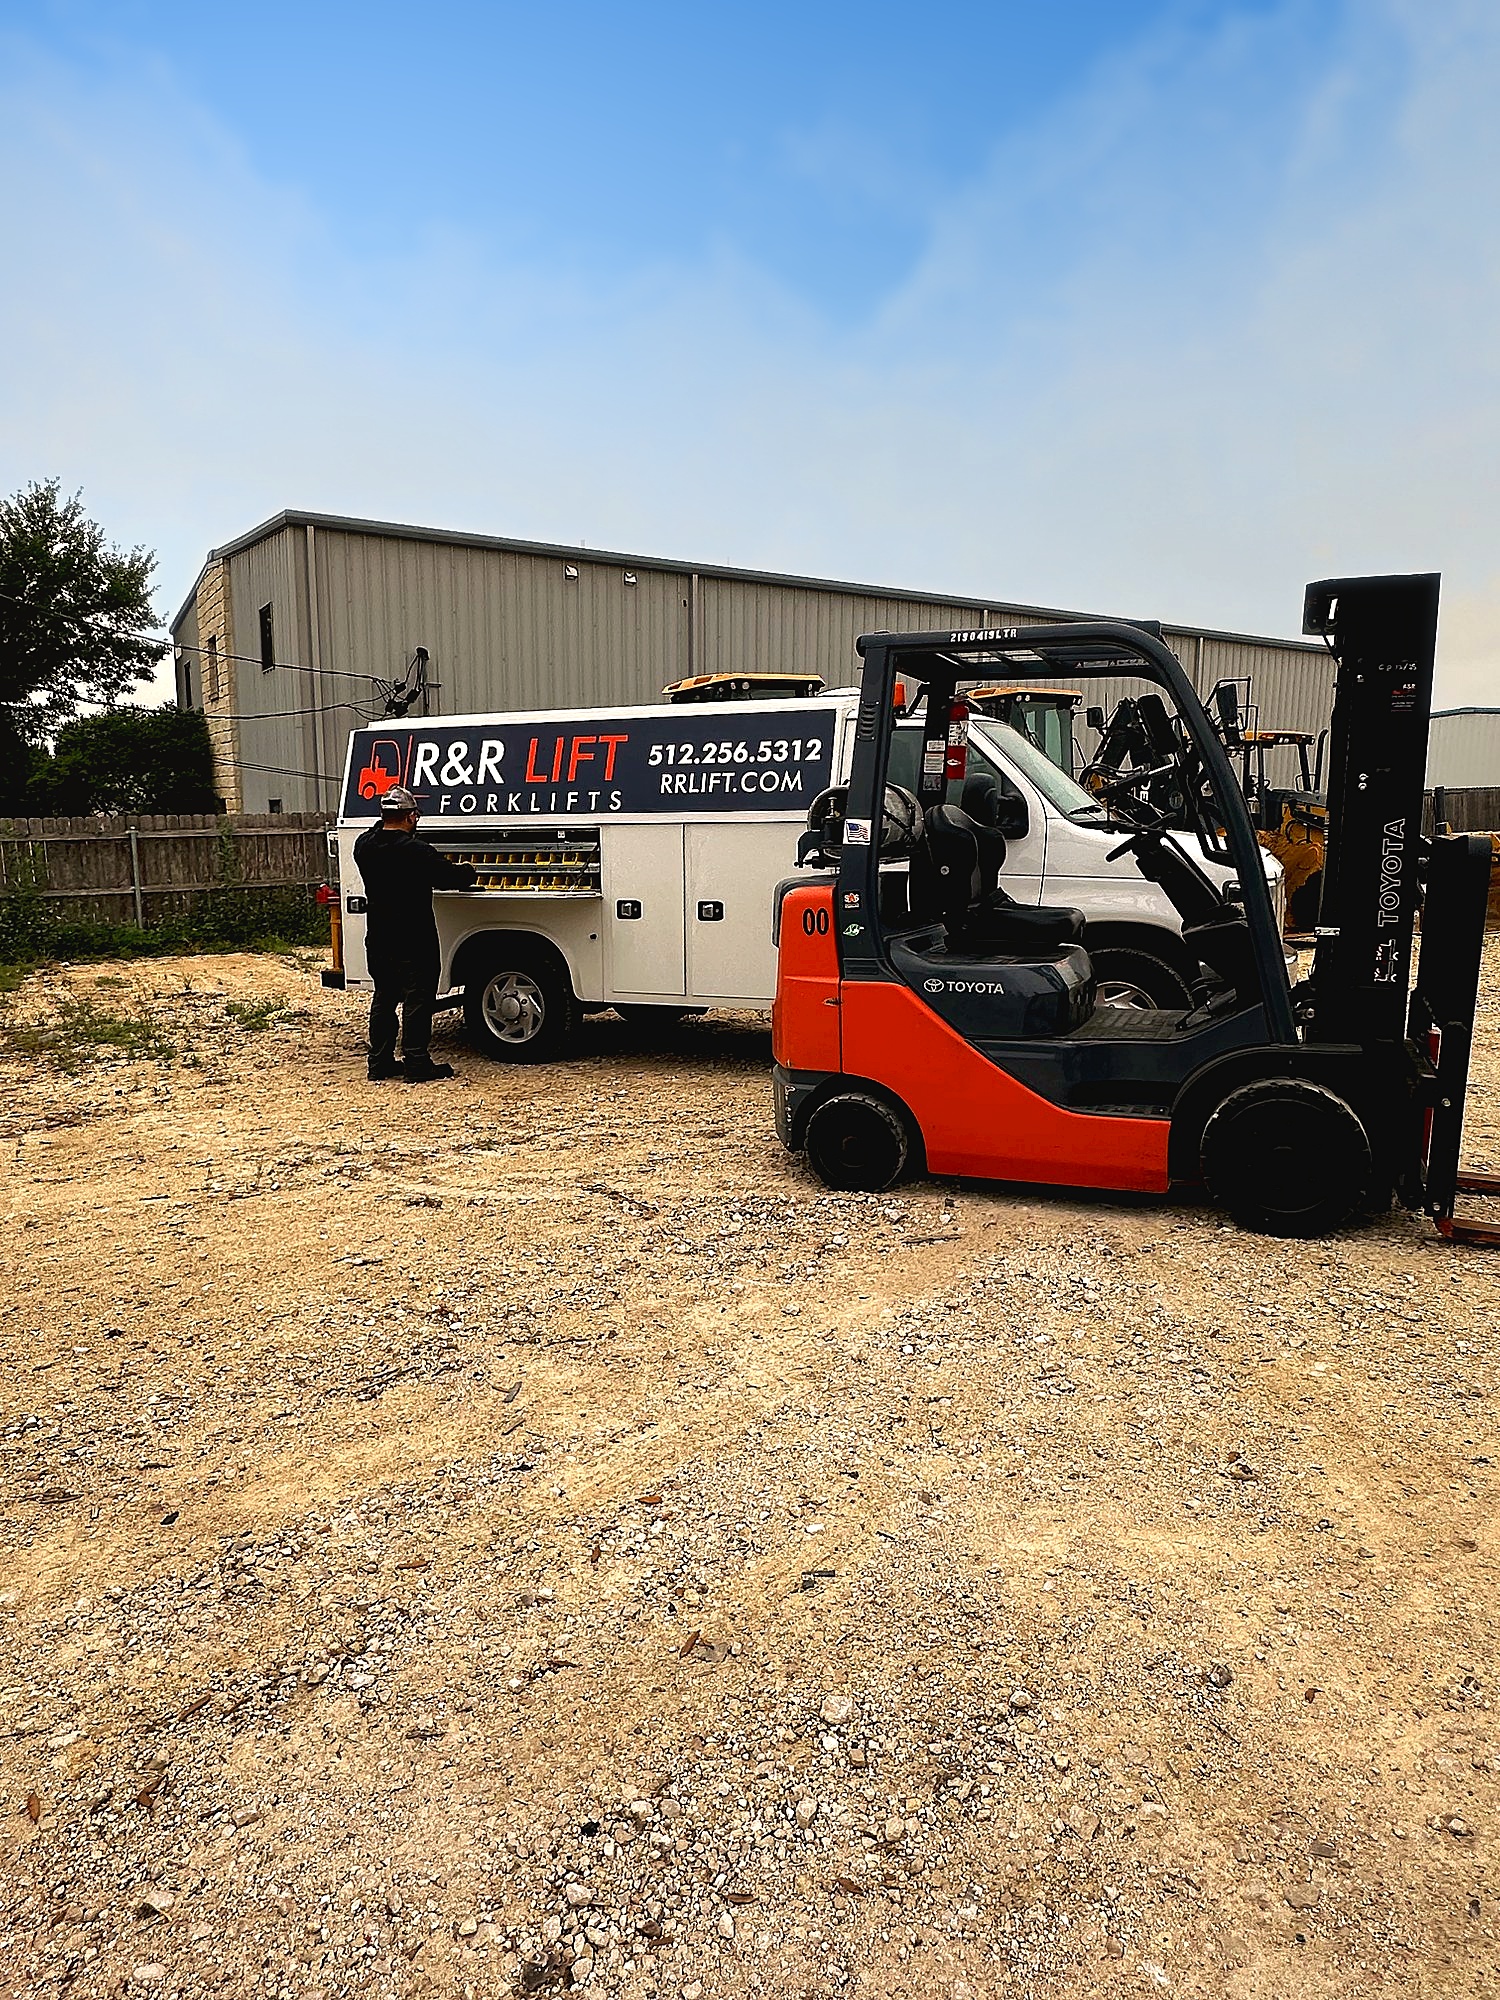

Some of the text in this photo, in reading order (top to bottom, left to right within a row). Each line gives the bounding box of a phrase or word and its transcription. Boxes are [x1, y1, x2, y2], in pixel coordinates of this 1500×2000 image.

[412, 734, 629, 787] R&R LIFT
[648, 739, 823, 767] 512.256.5312
[660, 770, 803, 795] RRLIFT.COM
[439, 790, 623, 814] FORKLIFTS
[1377, 818, 1406, 928] TOYOTA
[802, 907, 830, 936] 00
[946, 980, 1005, 996] TOYOTA
